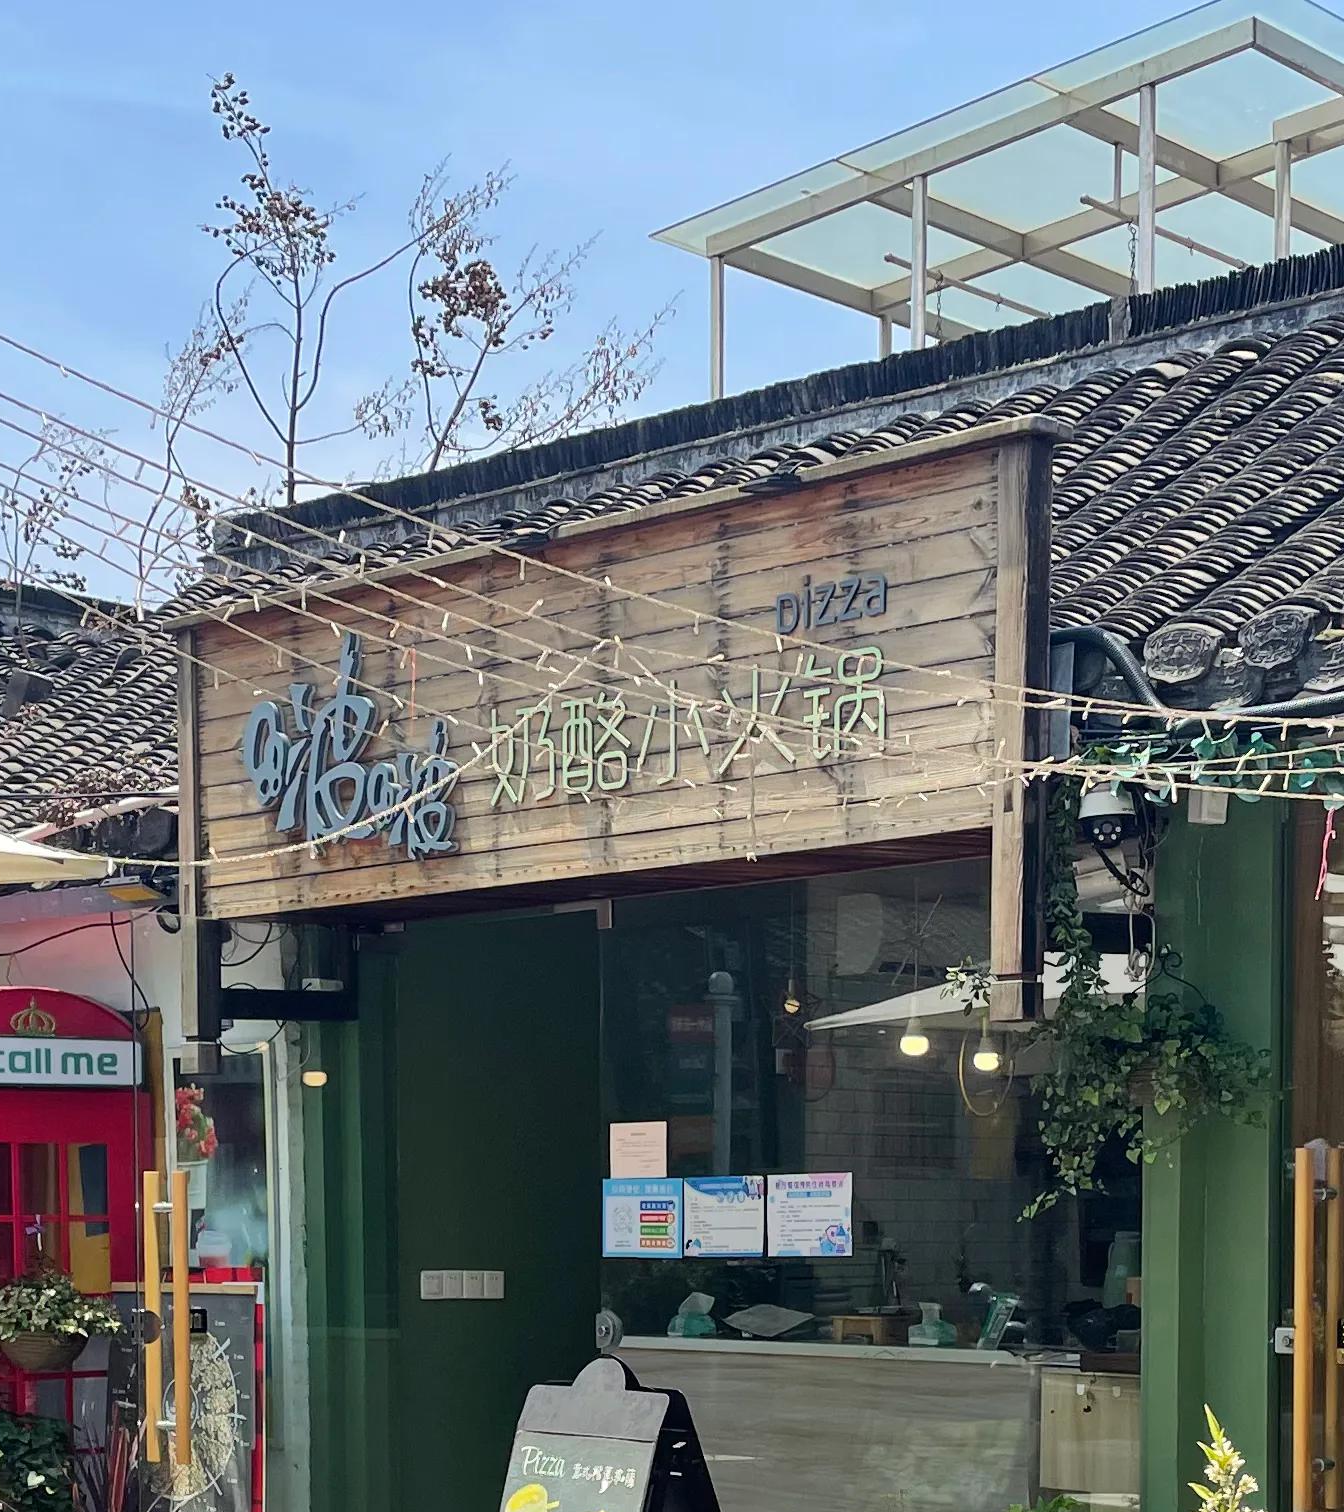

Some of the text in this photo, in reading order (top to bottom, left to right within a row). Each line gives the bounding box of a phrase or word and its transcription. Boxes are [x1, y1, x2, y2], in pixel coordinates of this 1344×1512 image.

[491, 646, 884, 806] 奶酪小火锅
[61, 1052, 118, 1075] me
[521, 1446, 566, 1478] Pizza
